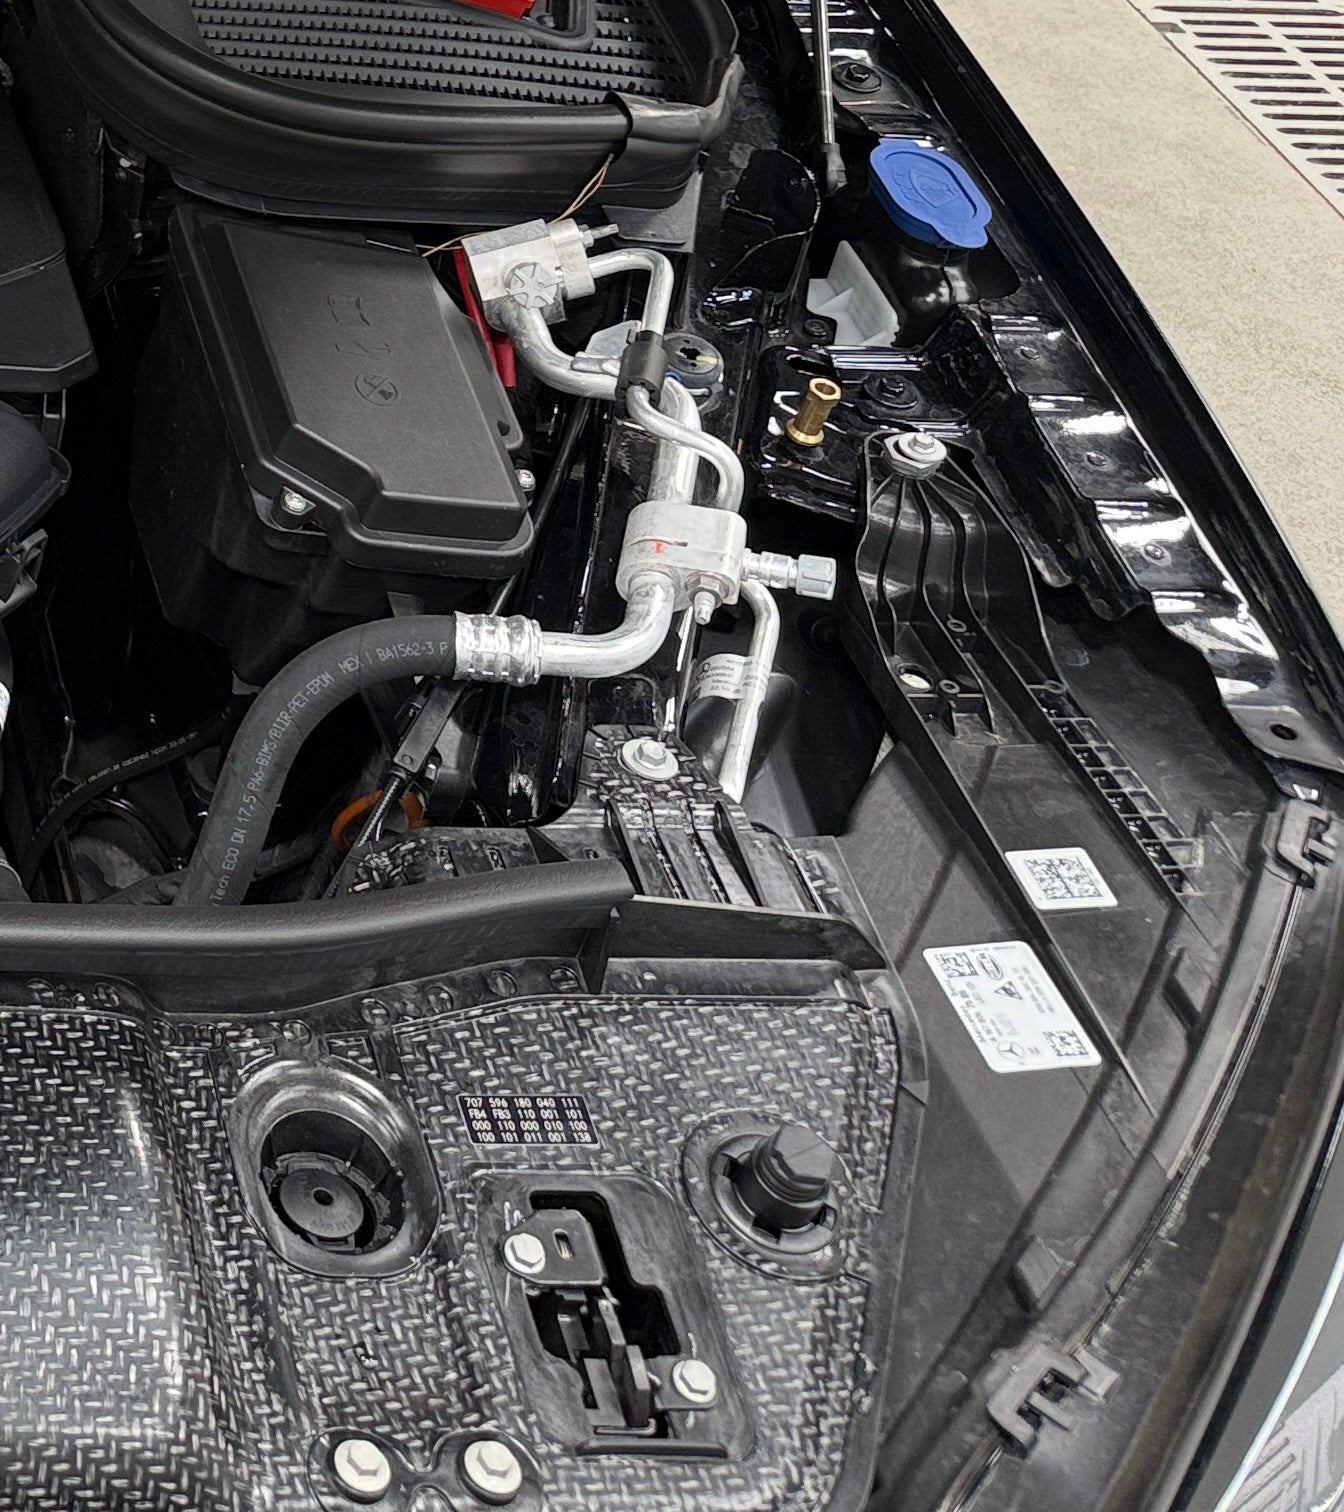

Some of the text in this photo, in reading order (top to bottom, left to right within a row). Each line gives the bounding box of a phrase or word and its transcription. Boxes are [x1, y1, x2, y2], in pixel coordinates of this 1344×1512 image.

[222, 847, 239, 871] ECO
[338, 656, 364, 675] MEX
[376, 641, 434, 662] BA1562-3
[464, 1097, 483, 1108] 707
[488, 1097, 508, 1108] 596
[536, 1097, 556, 1108] 040
[561, 1097, 579, 1108] 111
[468, 1109, 583, 1119] FB4 FB3 110 001 101
[472, 1120, 587, 1131] 000 110 000 010 100
[476, 1132, 495, 1143] 100
[500, 1132, 519, 1143] 101
[523, 1132, 543, 1143] 011
[547, 1132, 567, 1143] 001
